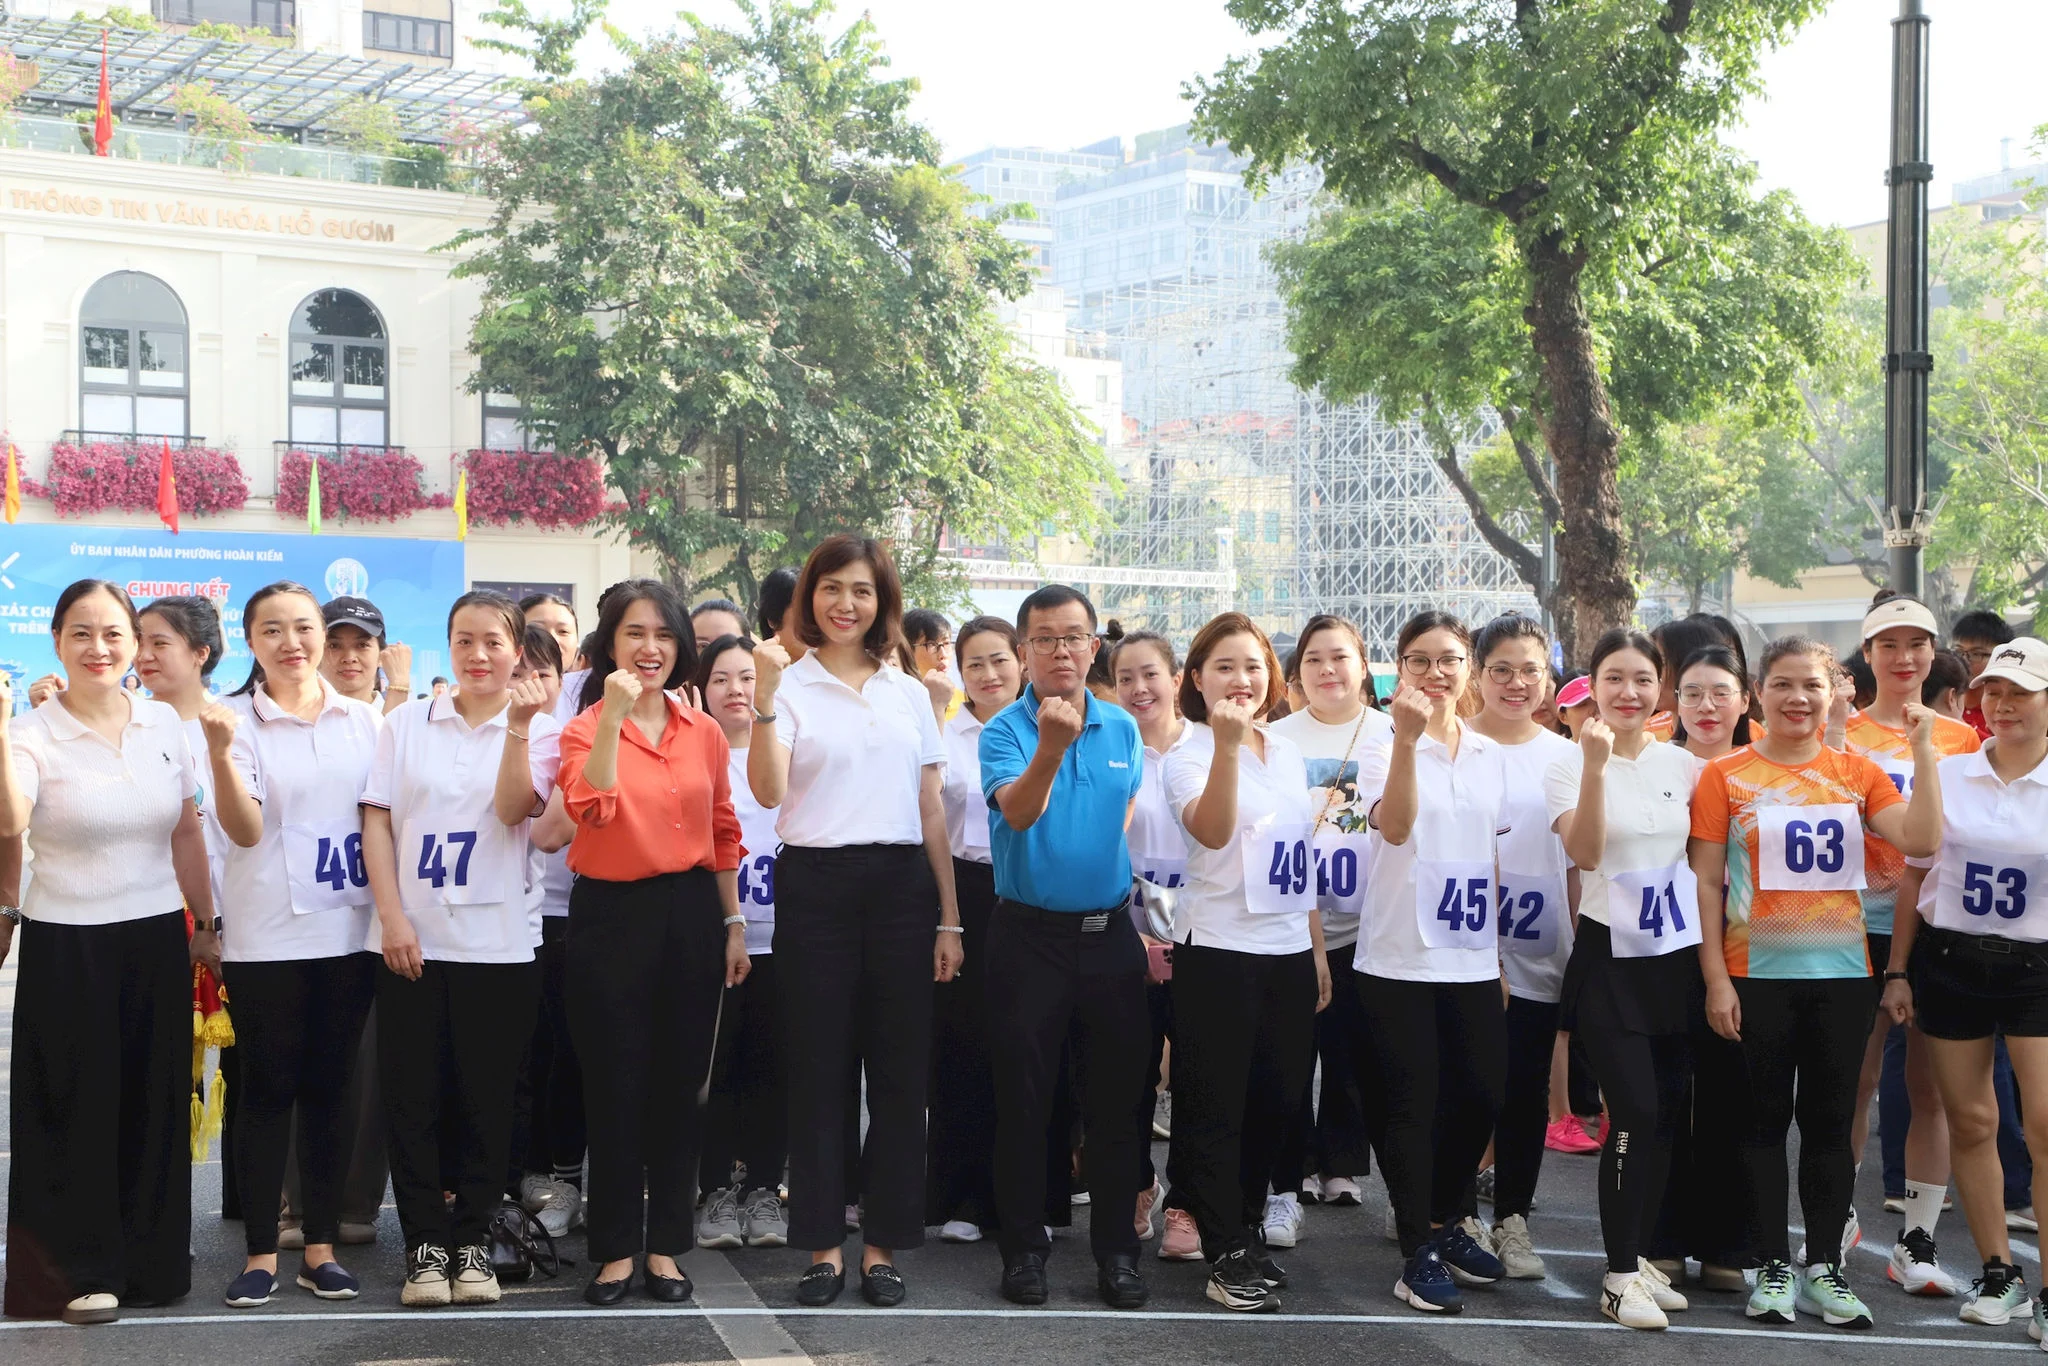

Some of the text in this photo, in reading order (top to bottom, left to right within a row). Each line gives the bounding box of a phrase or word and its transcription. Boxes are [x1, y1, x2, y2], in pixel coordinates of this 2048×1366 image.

[10, 188, 395, 243] THÔNG TIN VĂN HÓA HỒ GƯƠM
[70, 542, 283, 562] ỦY BAN NHÂN DÂN PHƯỜNG HOÀN KIẾM
[30, 605, 56, 618] CH
[127, 577, 231, 599] CHUNG KẾT
[7, 619, 49, 635] TRÊN
[315, 832, 369, 891] 46
[418, 831, 477, 888] 47
[1269, 839, 1307, 895] 49
[1313, 848, 1357, 898] 40
[1785, 818, 1844, 874] 63
[738, 854, 776, 905] 43
[1437, 878, 1488, 931] 45
[1963, 861, 2027, 919] 53
[1498, 885, 1544, 940] 42
[1639, 880, 1686, 938] 41
[1617, 1131, 1629, 1154] RUN
